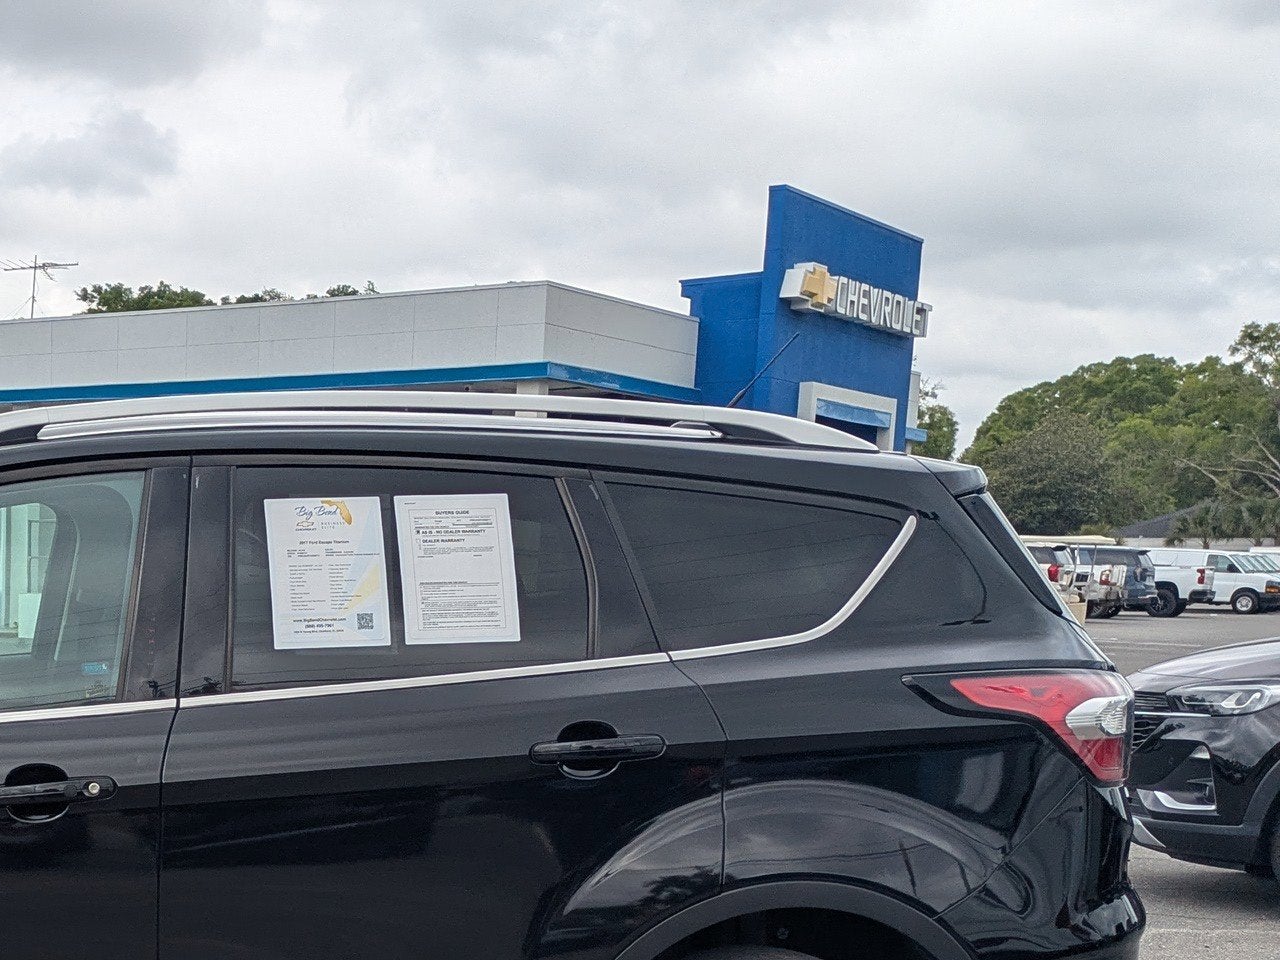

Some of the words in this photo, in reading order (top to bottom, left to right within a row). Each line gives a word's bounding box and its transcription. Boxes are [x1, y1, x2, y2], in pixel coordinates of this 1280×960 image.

[836, 276, 933, 338] CHEVROLET
[294, 505, 314, 520] Big
[314, 505, 339, 516] Bend
